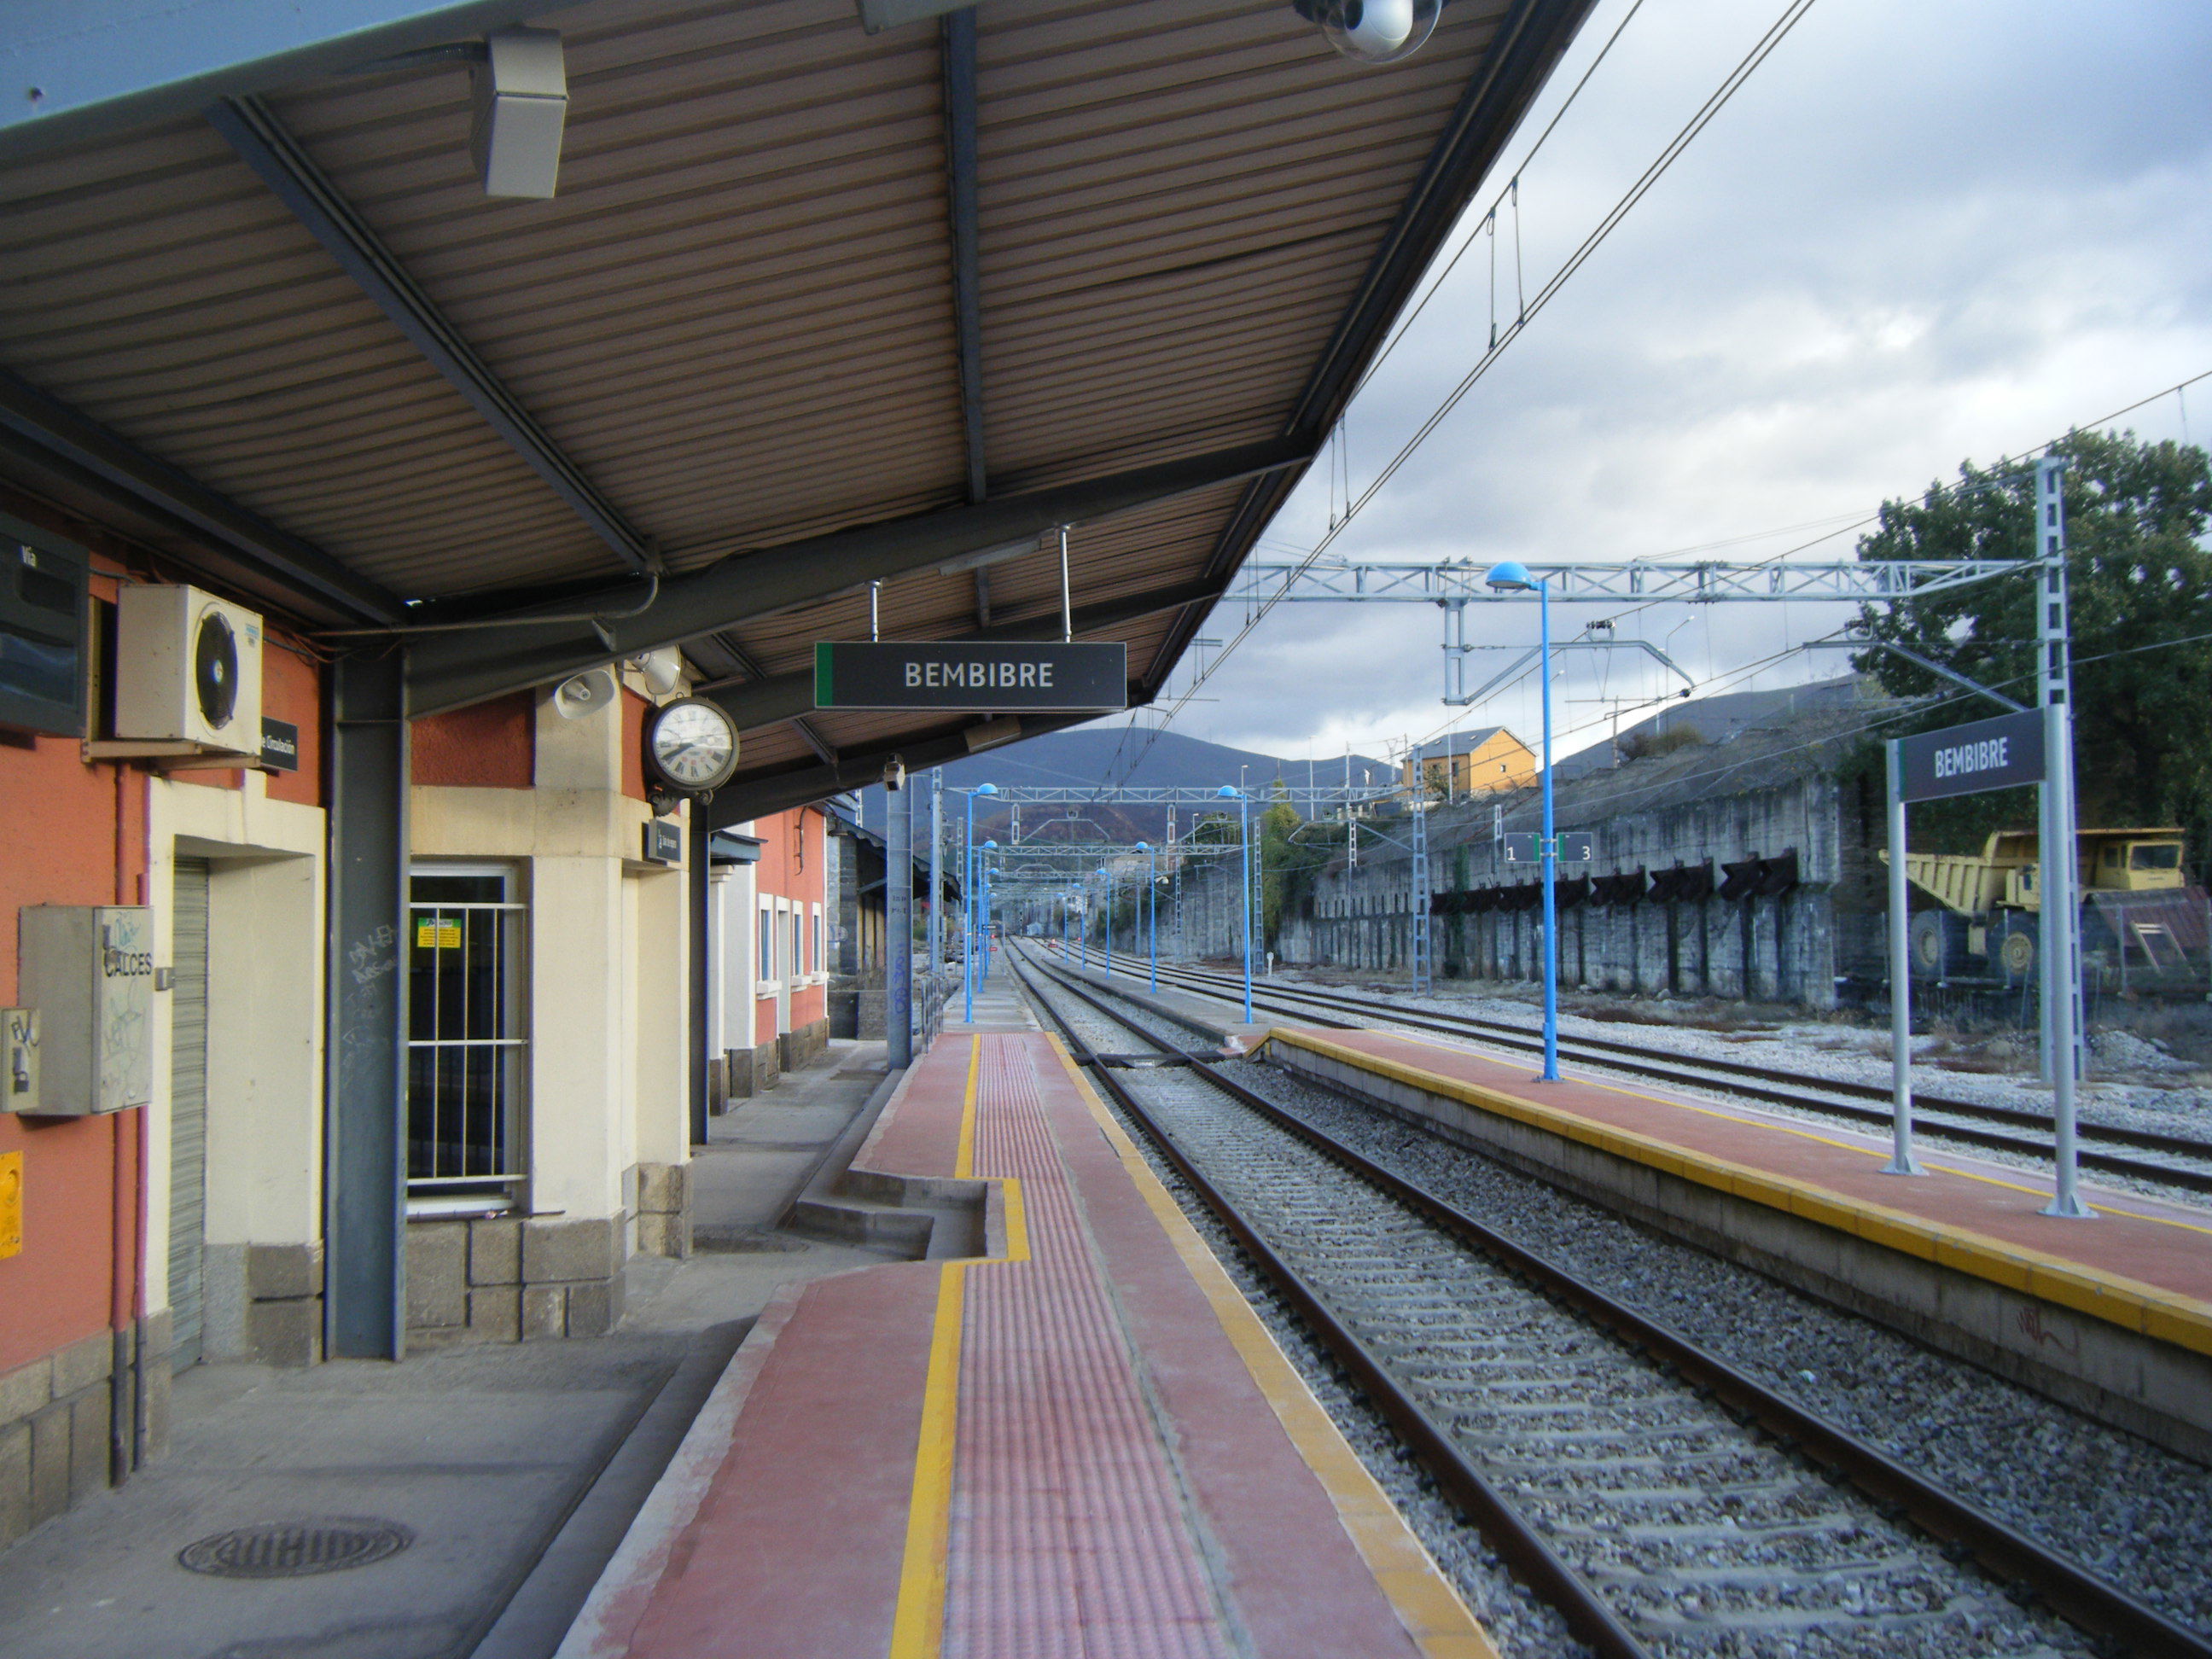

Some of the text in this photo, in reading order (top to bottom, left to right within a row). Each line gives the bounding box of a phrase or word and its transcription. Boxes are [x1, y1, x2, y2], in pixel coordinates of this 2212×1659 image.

[905, 662, 1054, 688] BEMBIBRE
[1935, 736, 2009, 778] BEMBIBRE
[1507, 847, 1516, 861] 1
[1582, 846, 1591, 860] 3
